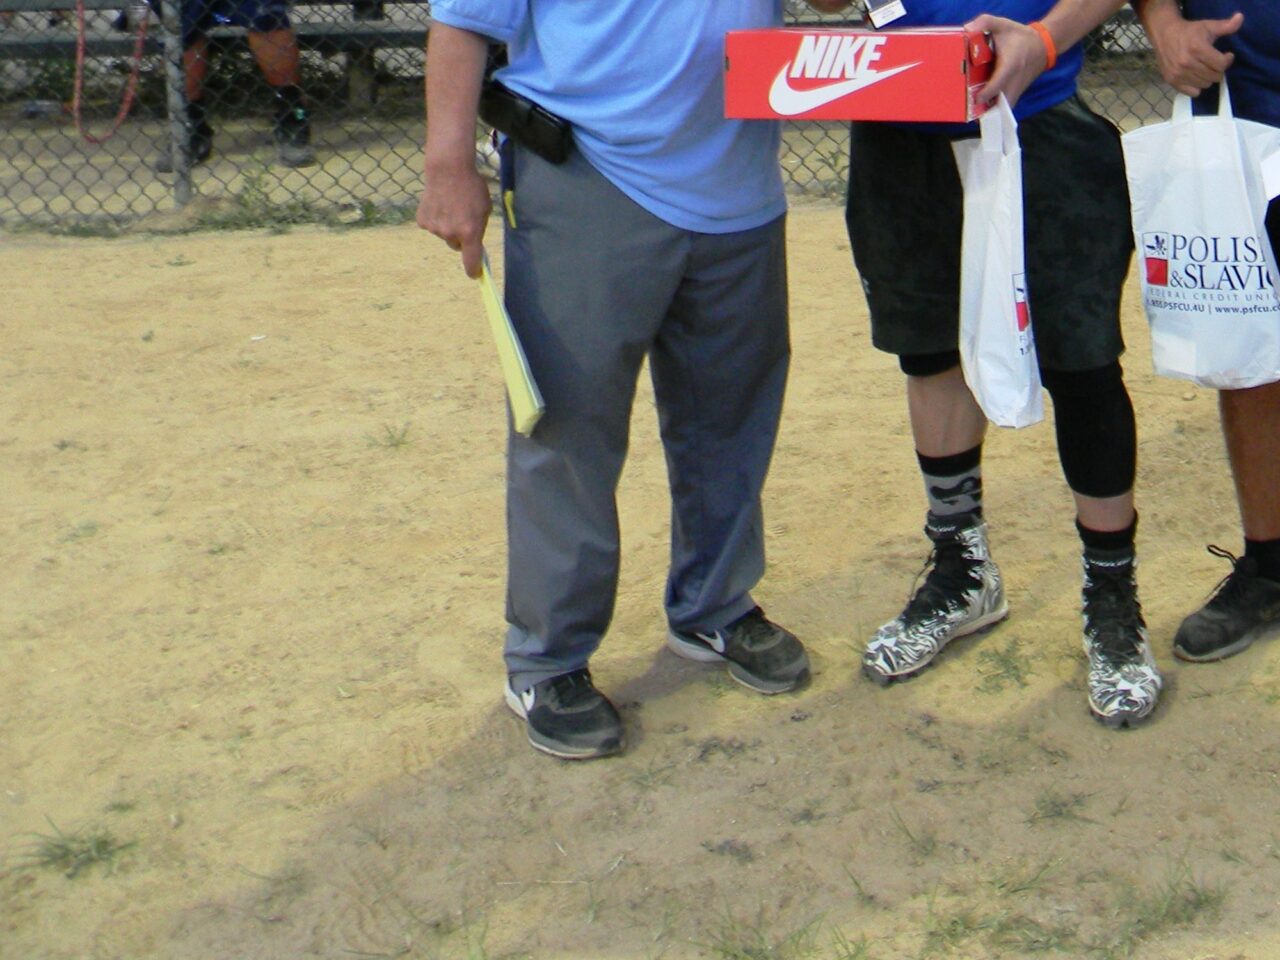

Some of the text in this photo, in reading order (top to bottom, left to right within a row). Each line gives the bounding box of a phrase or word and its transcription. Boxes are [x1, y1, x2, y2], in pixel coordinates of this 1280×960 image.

[789, 34, 888, 79] NIKE
[1171, 233, 1266, 263] POLIS
[1193, 292, 1239, 302] CREDIT
